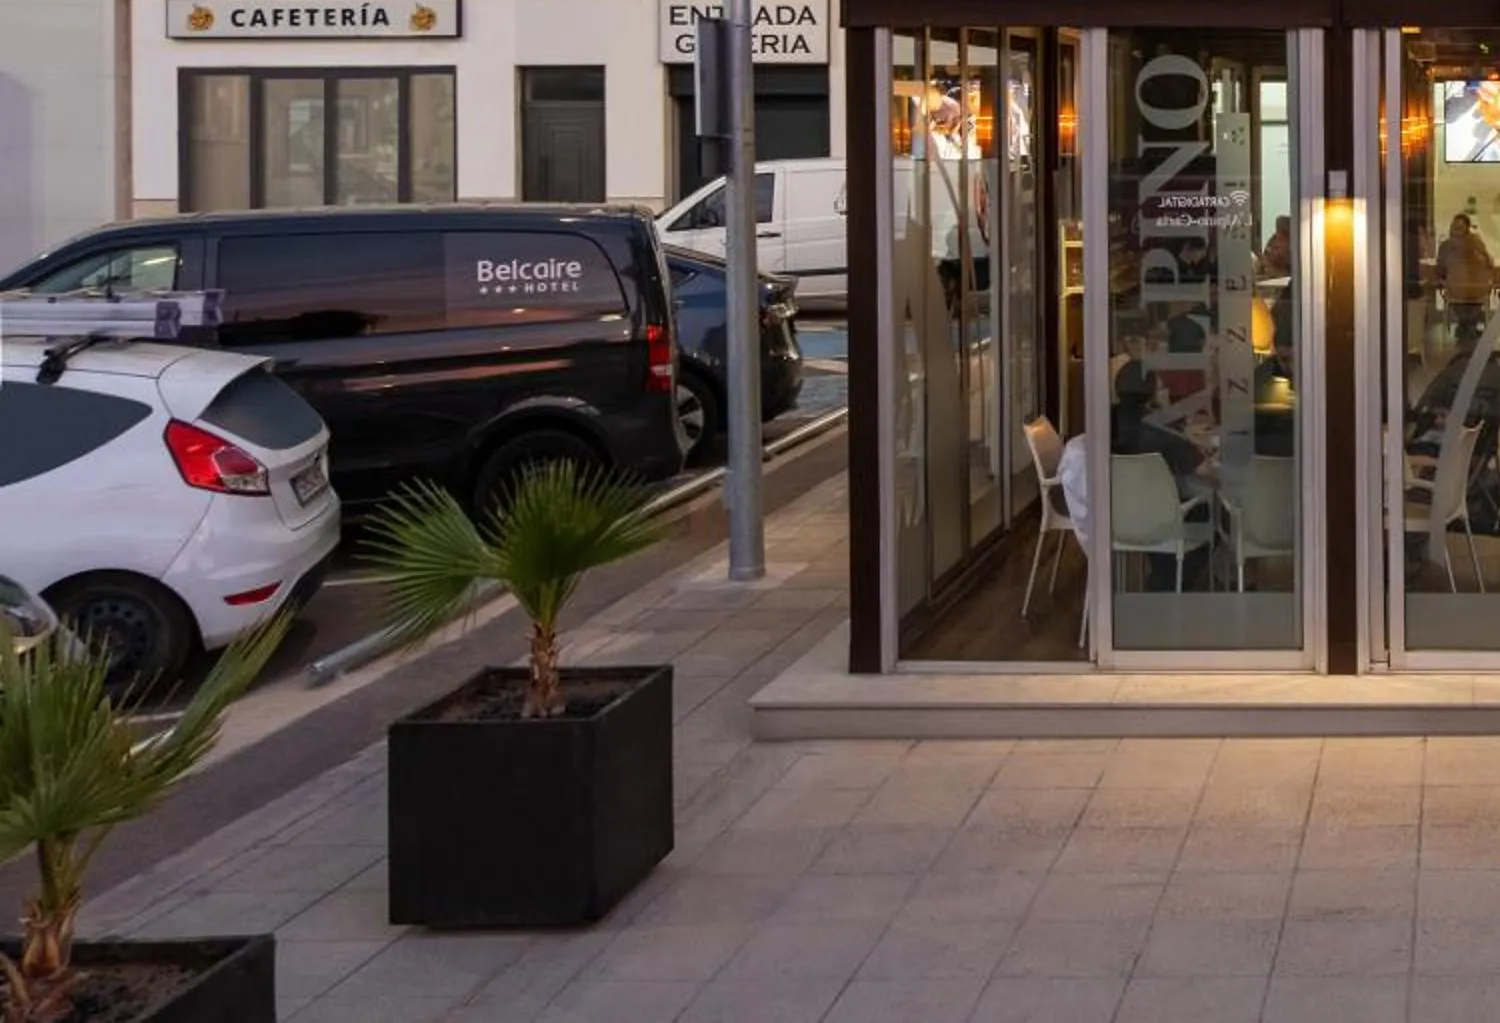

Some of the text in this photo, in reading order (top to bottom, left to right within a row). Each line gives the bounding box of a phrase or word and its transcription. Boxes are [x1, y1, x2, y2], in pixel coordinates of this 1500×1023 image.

[231, 3, 390, 27] CAFETERÍA
[669, 5, 817, 26] ENTADA
[477, 258, 581, 282] Belcaire
[525, 281, 580, 293] HOTEL
